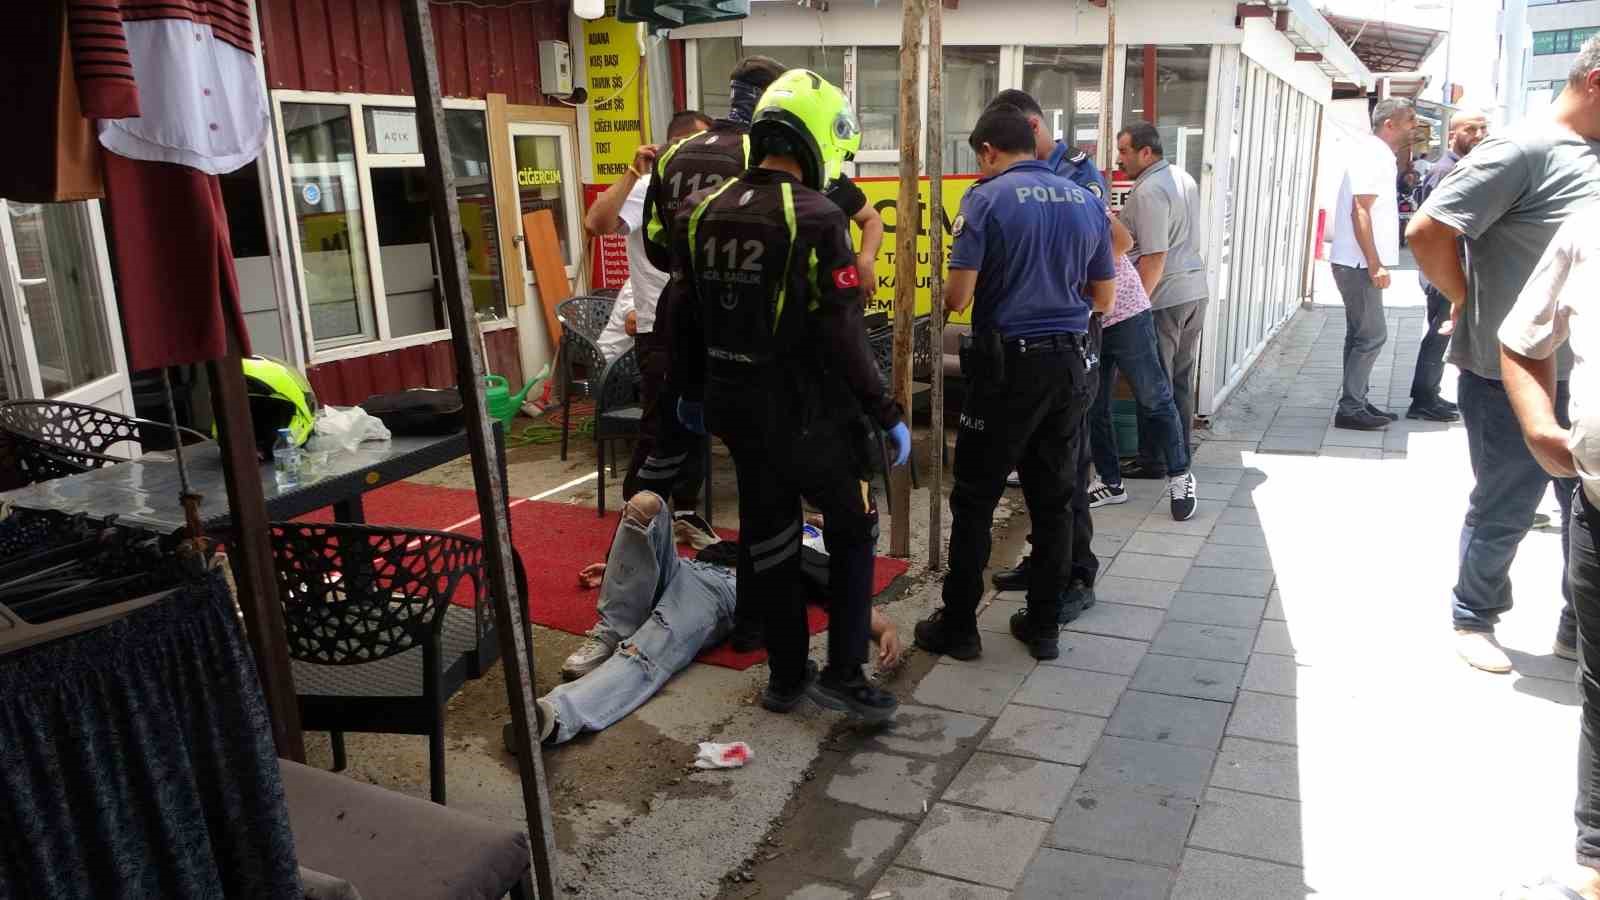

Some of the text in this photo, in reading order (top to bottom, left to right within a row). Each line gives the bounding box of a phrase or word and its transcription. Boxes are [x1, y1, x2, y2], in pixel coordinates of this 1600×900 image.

[588, 32, 610, 45] ADANA
[592, 77, 611, 89] TAVUK
[613, 119, 641, 132] KAVURM
[596, 142, 611, 154] TOST
[703, 236, 765, 270] 112
